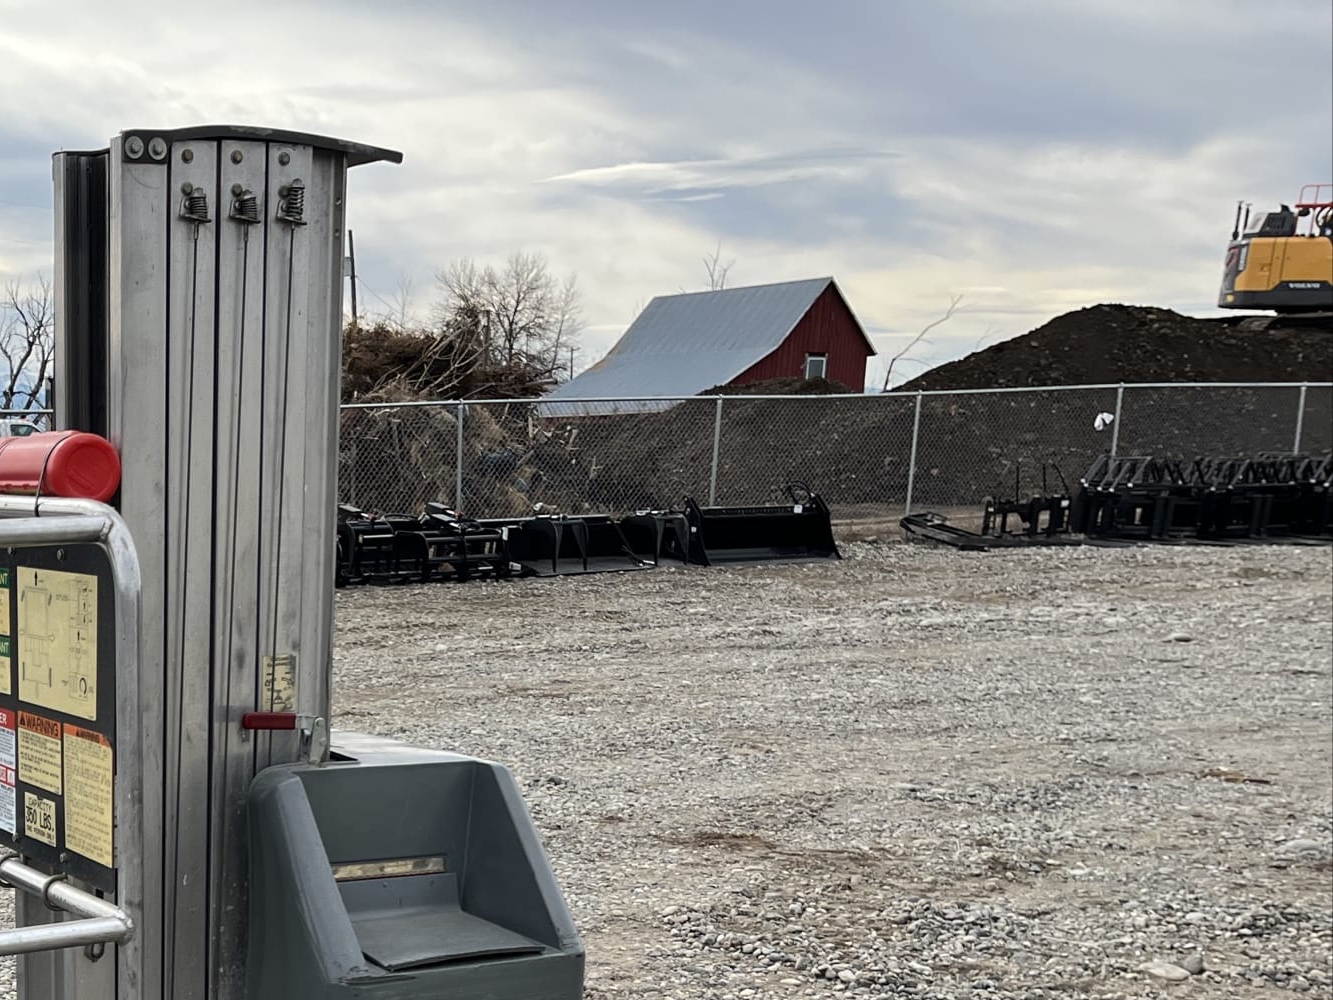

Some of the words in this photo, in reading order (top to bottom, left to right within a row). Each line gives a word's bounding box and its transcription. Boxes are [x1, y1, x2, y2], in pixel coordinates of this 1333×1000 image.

[26, 714, 59, 737] WARNING
[28, 797, 51, 812] CAPACITY
[26, 805, 37, 825] 350
[40, 811, 54, 832] LBS.
